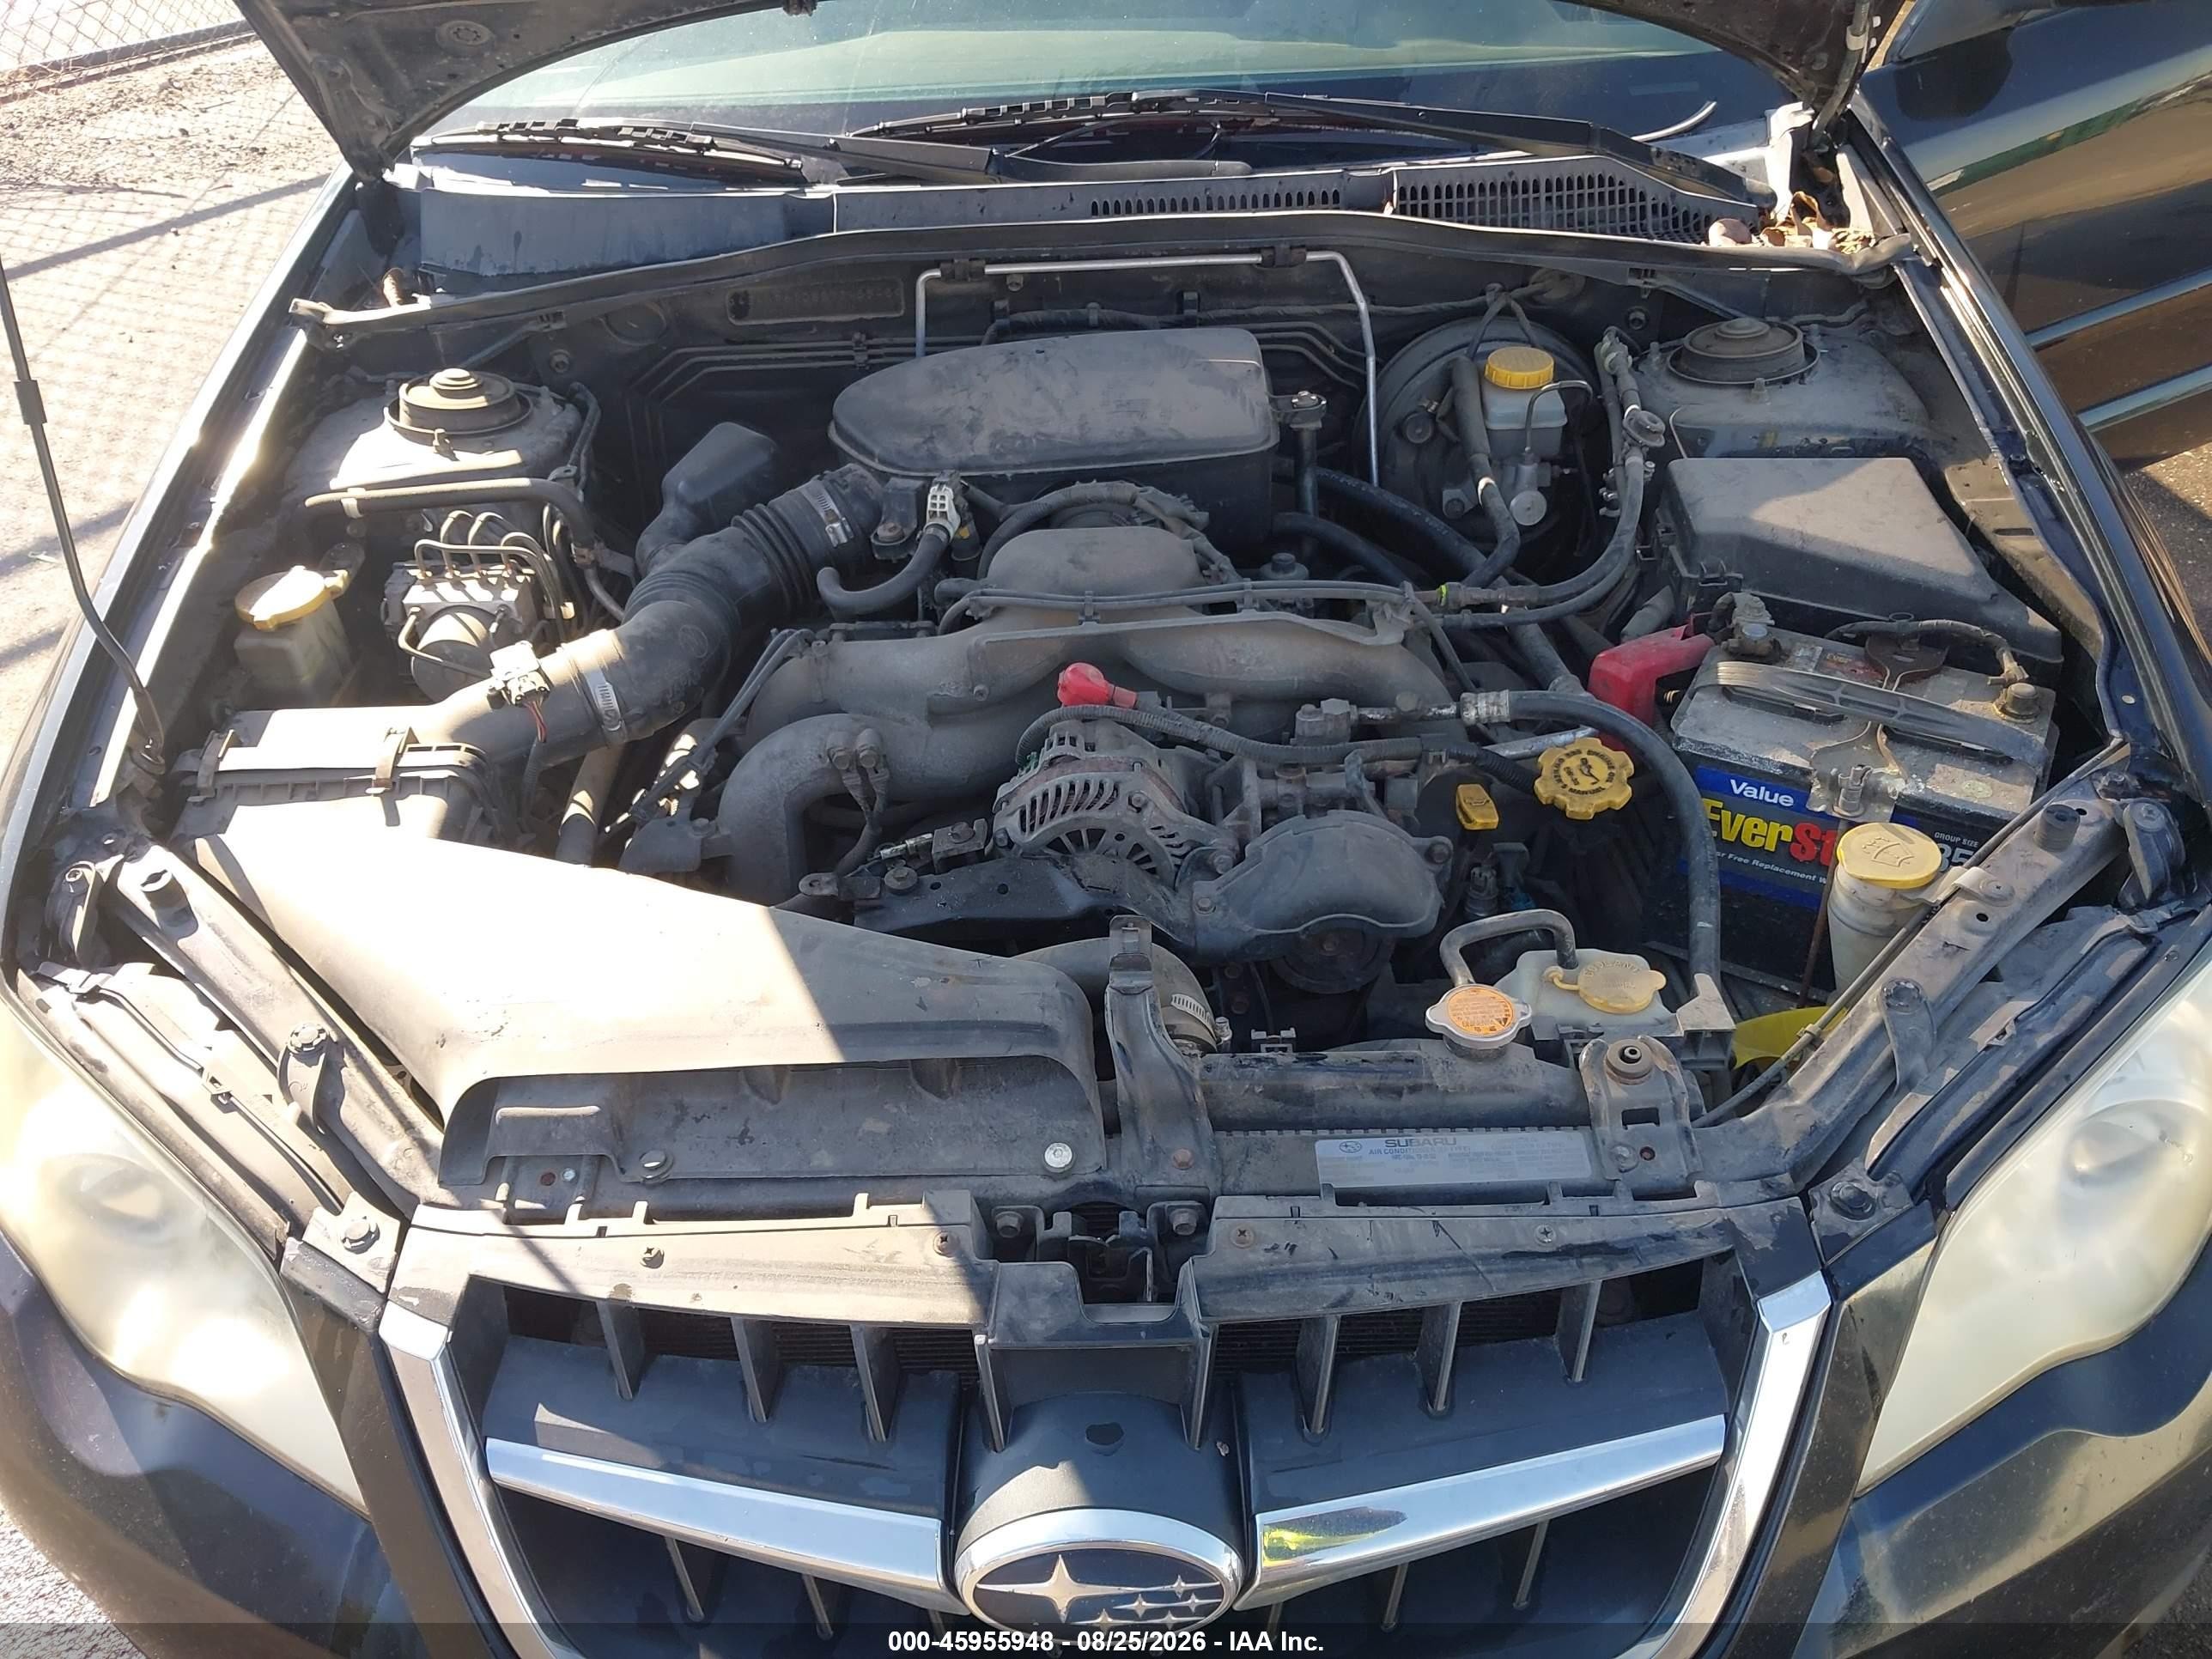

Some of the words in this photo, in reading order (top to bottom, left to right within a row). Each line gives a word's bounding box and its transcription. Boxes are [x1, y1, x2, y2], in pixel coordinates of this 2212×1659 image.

[1729, 779, 1795, 807] Value
[1934, 831, 1961, 843] GROUP
[1961, 838, 1979, 848] SIZE
[1727, 853, 1751, 864] Free
[1752, 859, 1817, 882] Replacement
[1384, 1138, 1457, 1148] SUBARU
